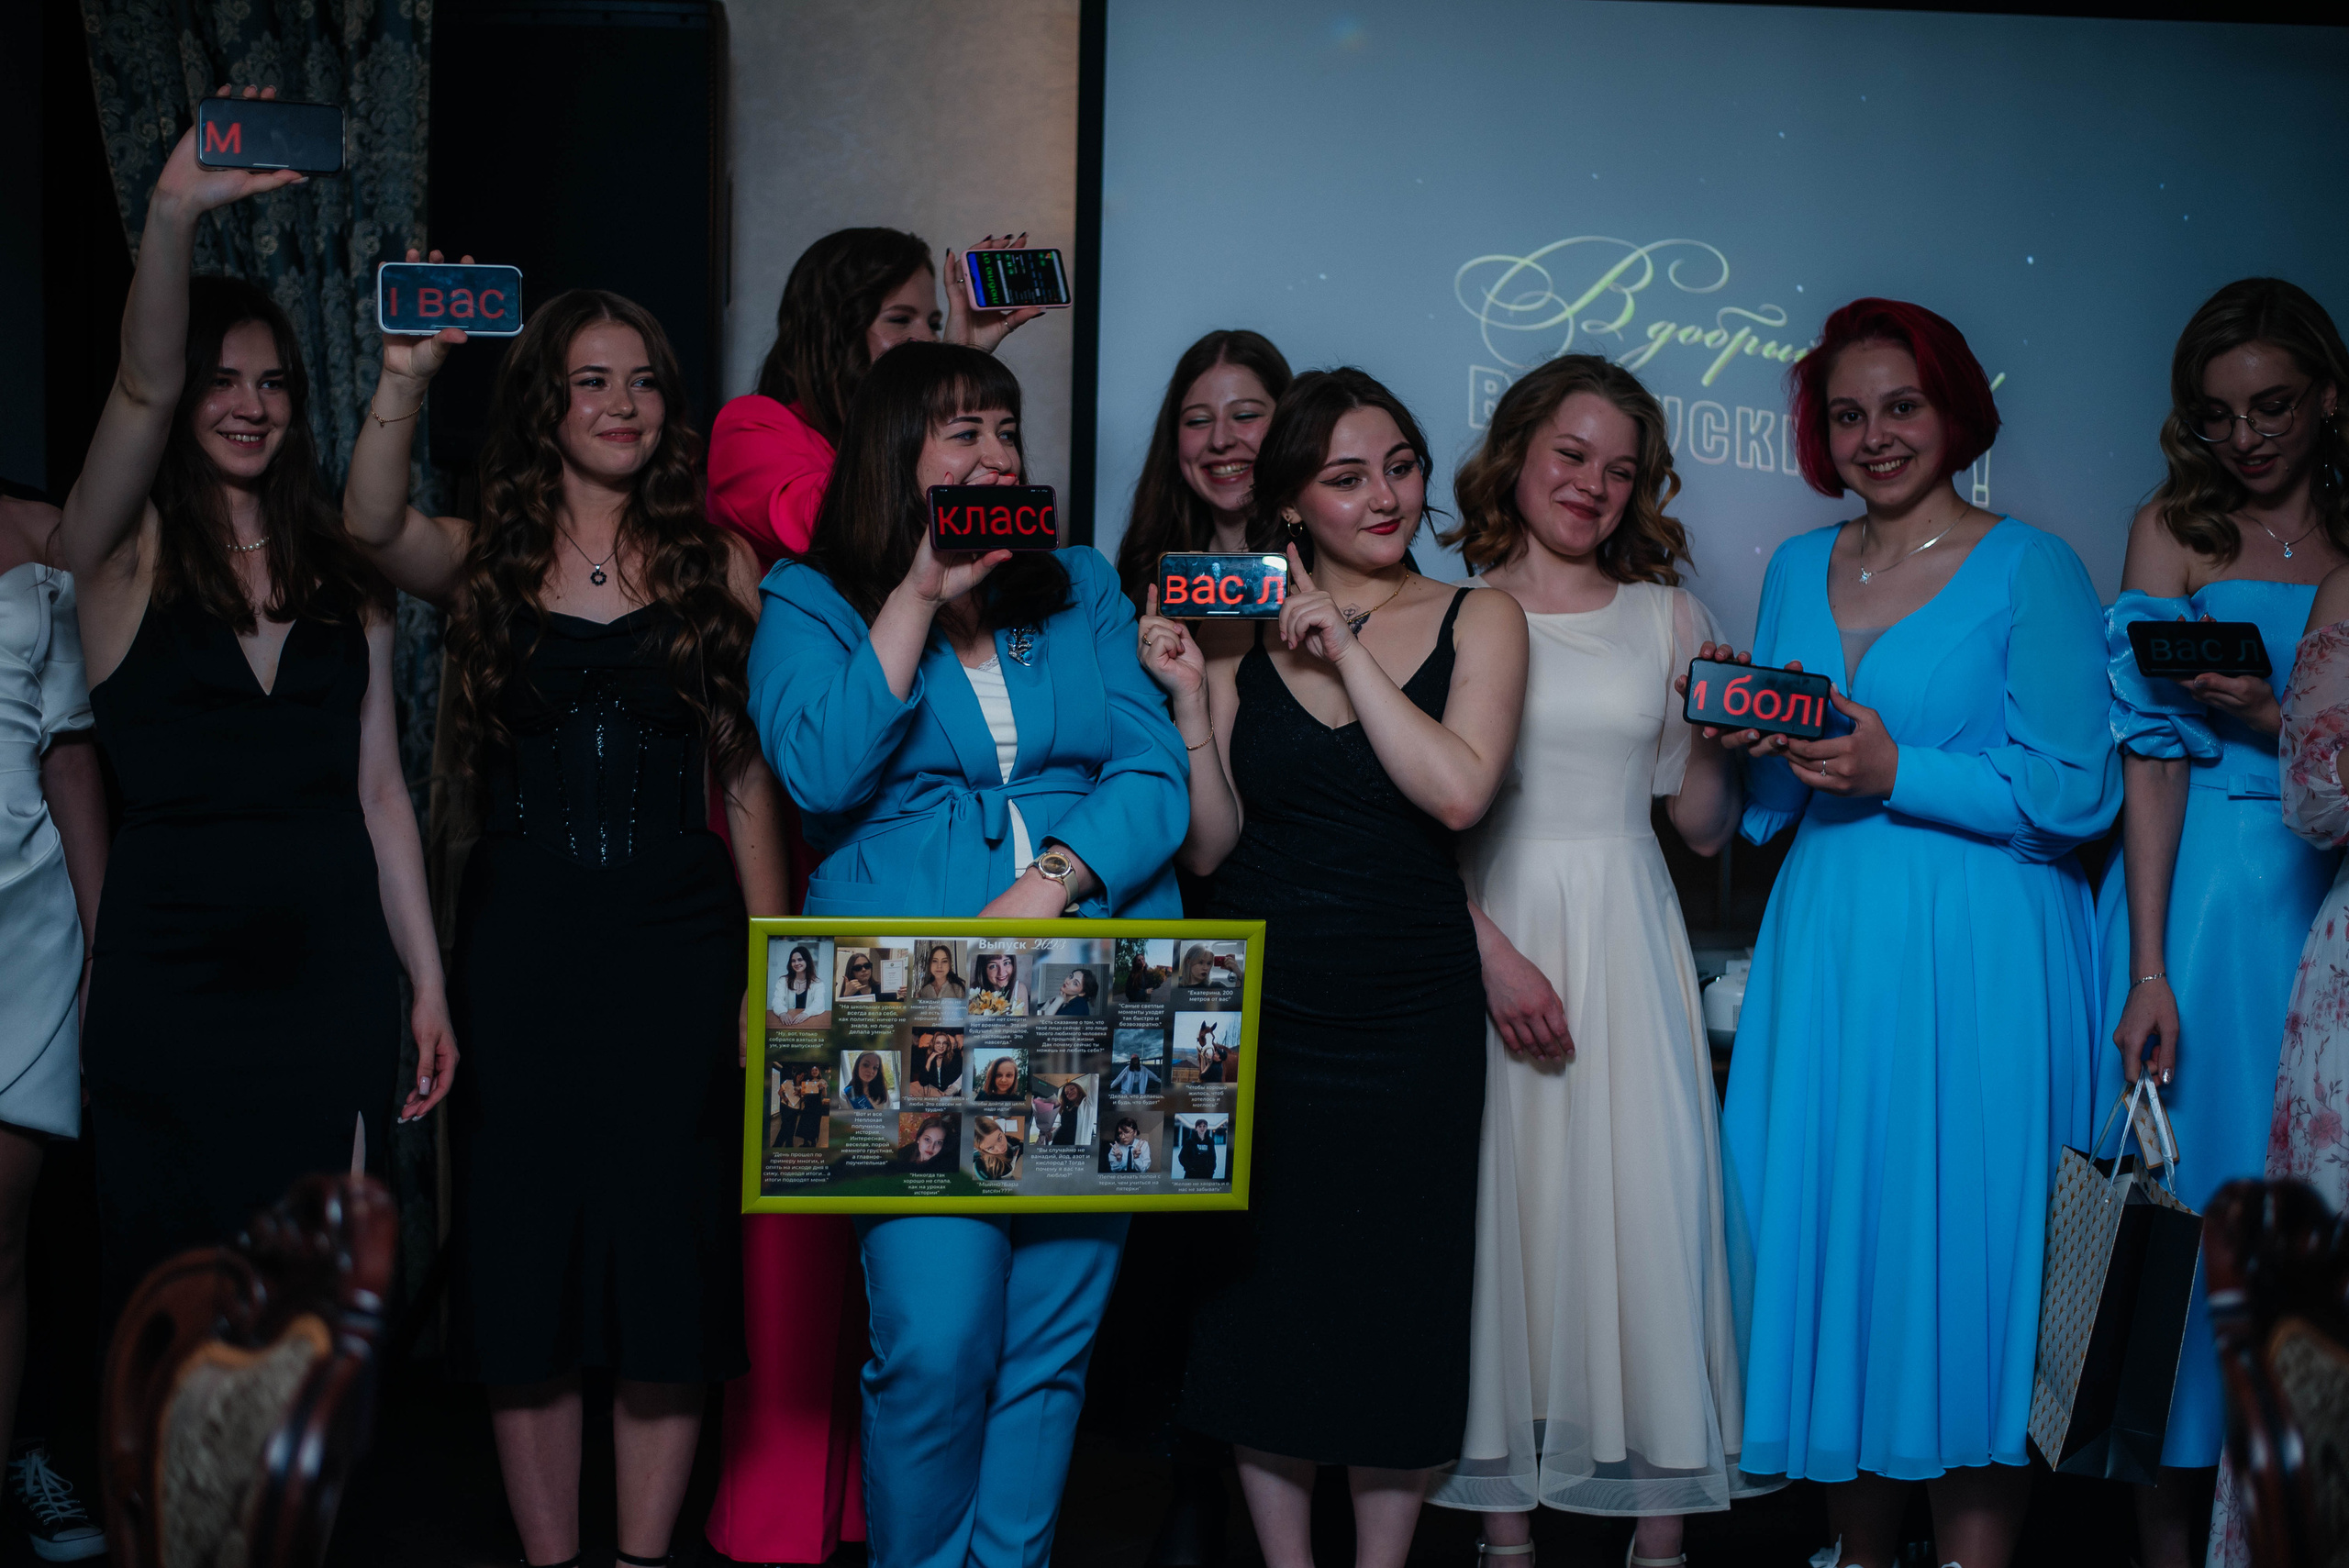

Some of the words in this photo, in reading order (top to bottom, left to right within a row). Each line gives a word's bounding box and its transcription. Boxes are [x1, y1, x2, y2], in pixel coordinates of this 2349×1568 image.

[417, 287, 505, 320] вас
[1163, 574, 1245, 606] вас
[978, 939, 1027, 951] Выпуск
